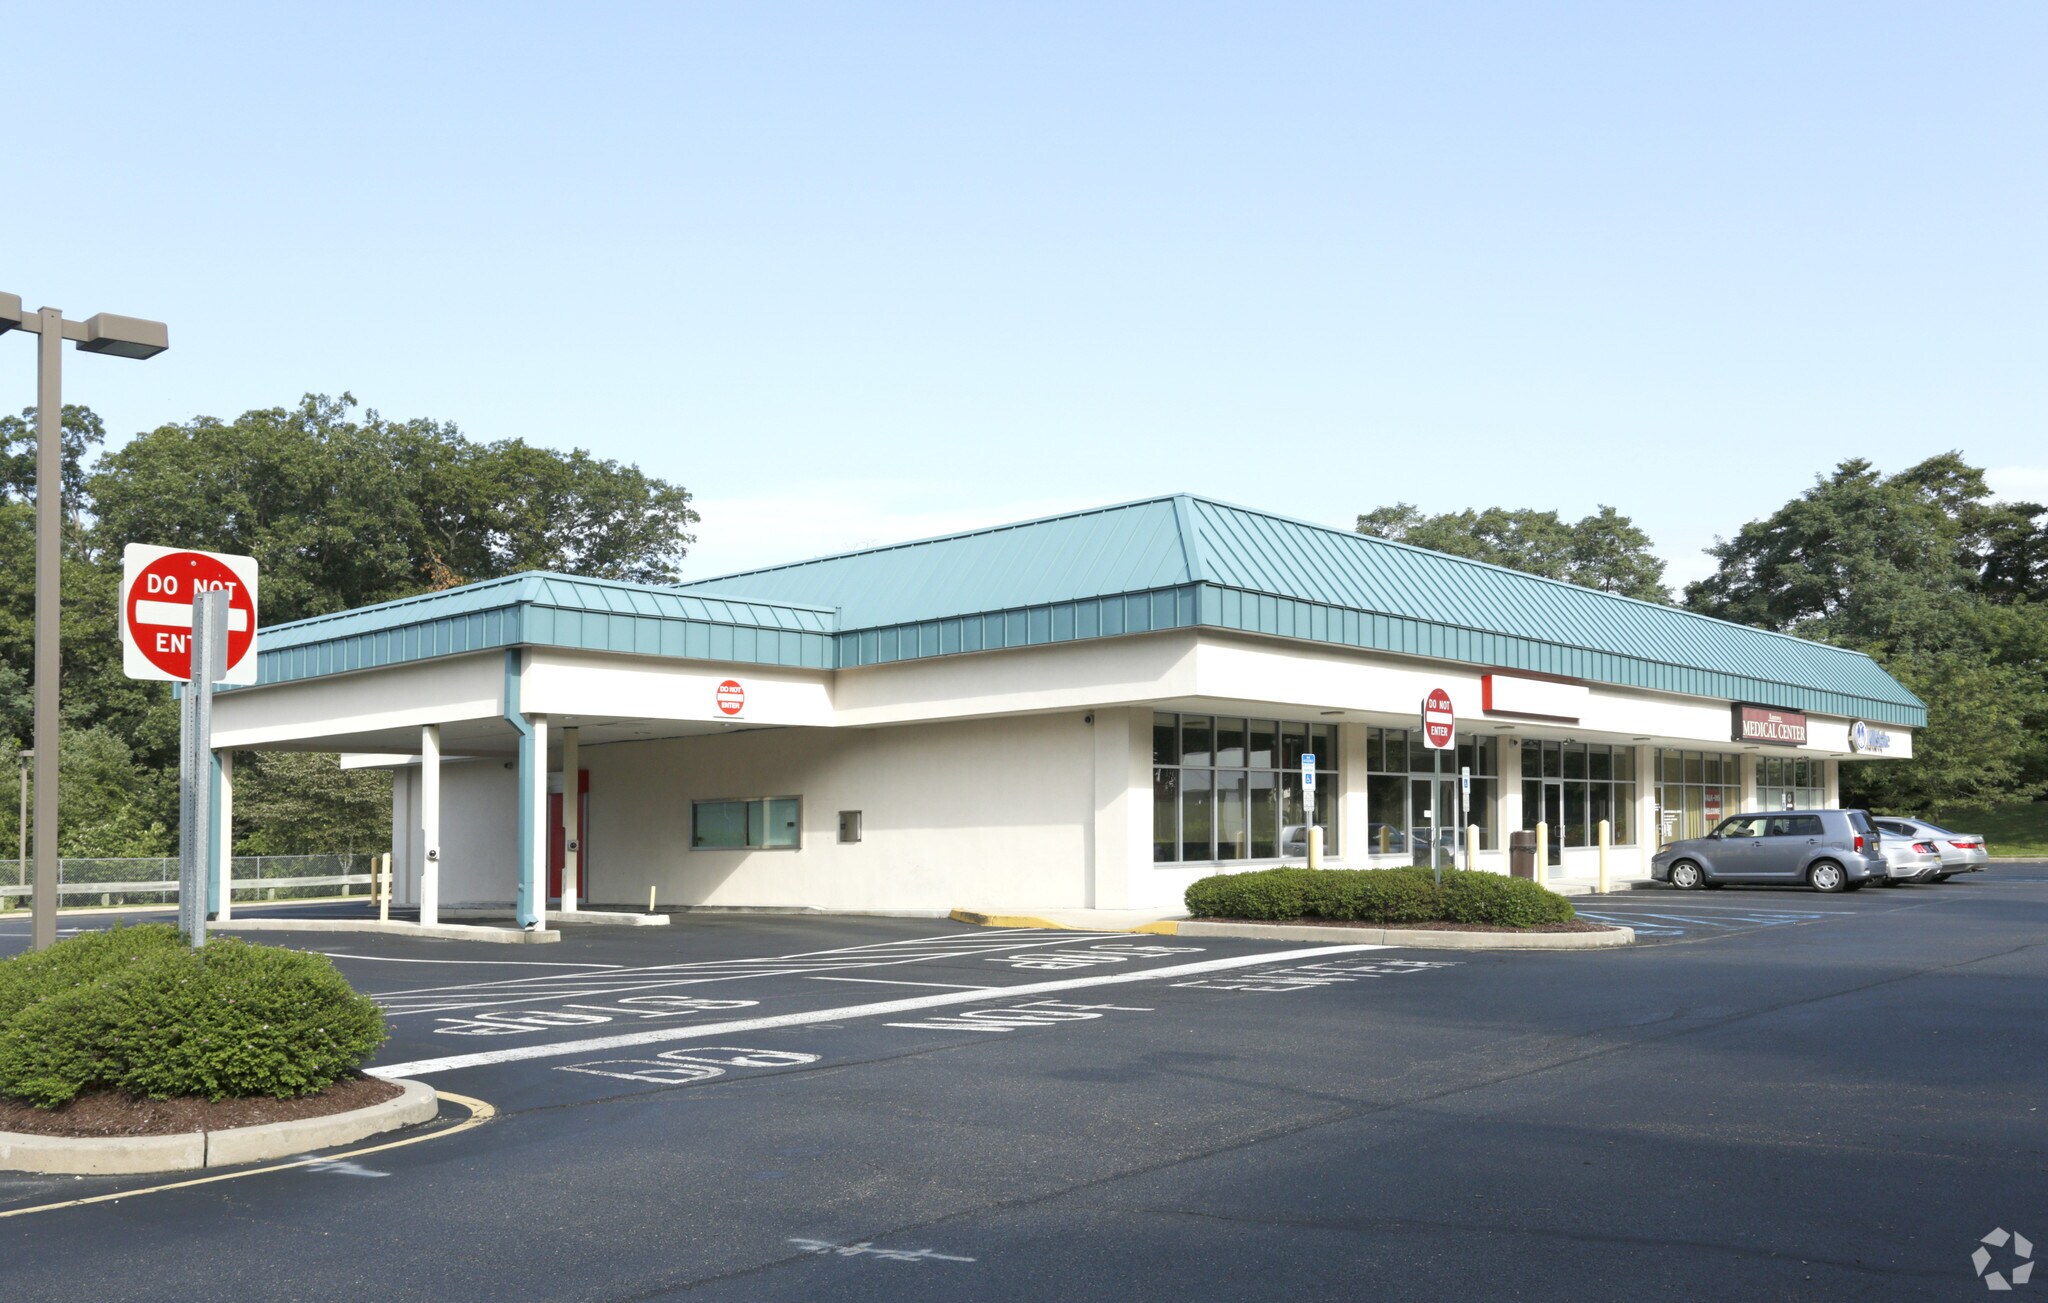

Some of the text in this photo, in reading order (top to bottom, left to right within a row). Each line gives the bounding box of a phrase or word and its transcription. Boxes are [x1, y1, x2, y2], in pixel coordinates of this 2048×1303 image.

[147, 573, 237, 601] DO NOT
[721, 701, 740, 709] ENTER
[1428, 699, 1450, 710] DO NOT
[1431, 726, 1448, 736] ENTER
[1743, 719, 1806, 741] MEDICAL CENTER
[984, 943, 1207, 970] STOP
[433, 995, 760, 1036] STOP
[552, 957, 1467, 1085] DO NOT ENTER
